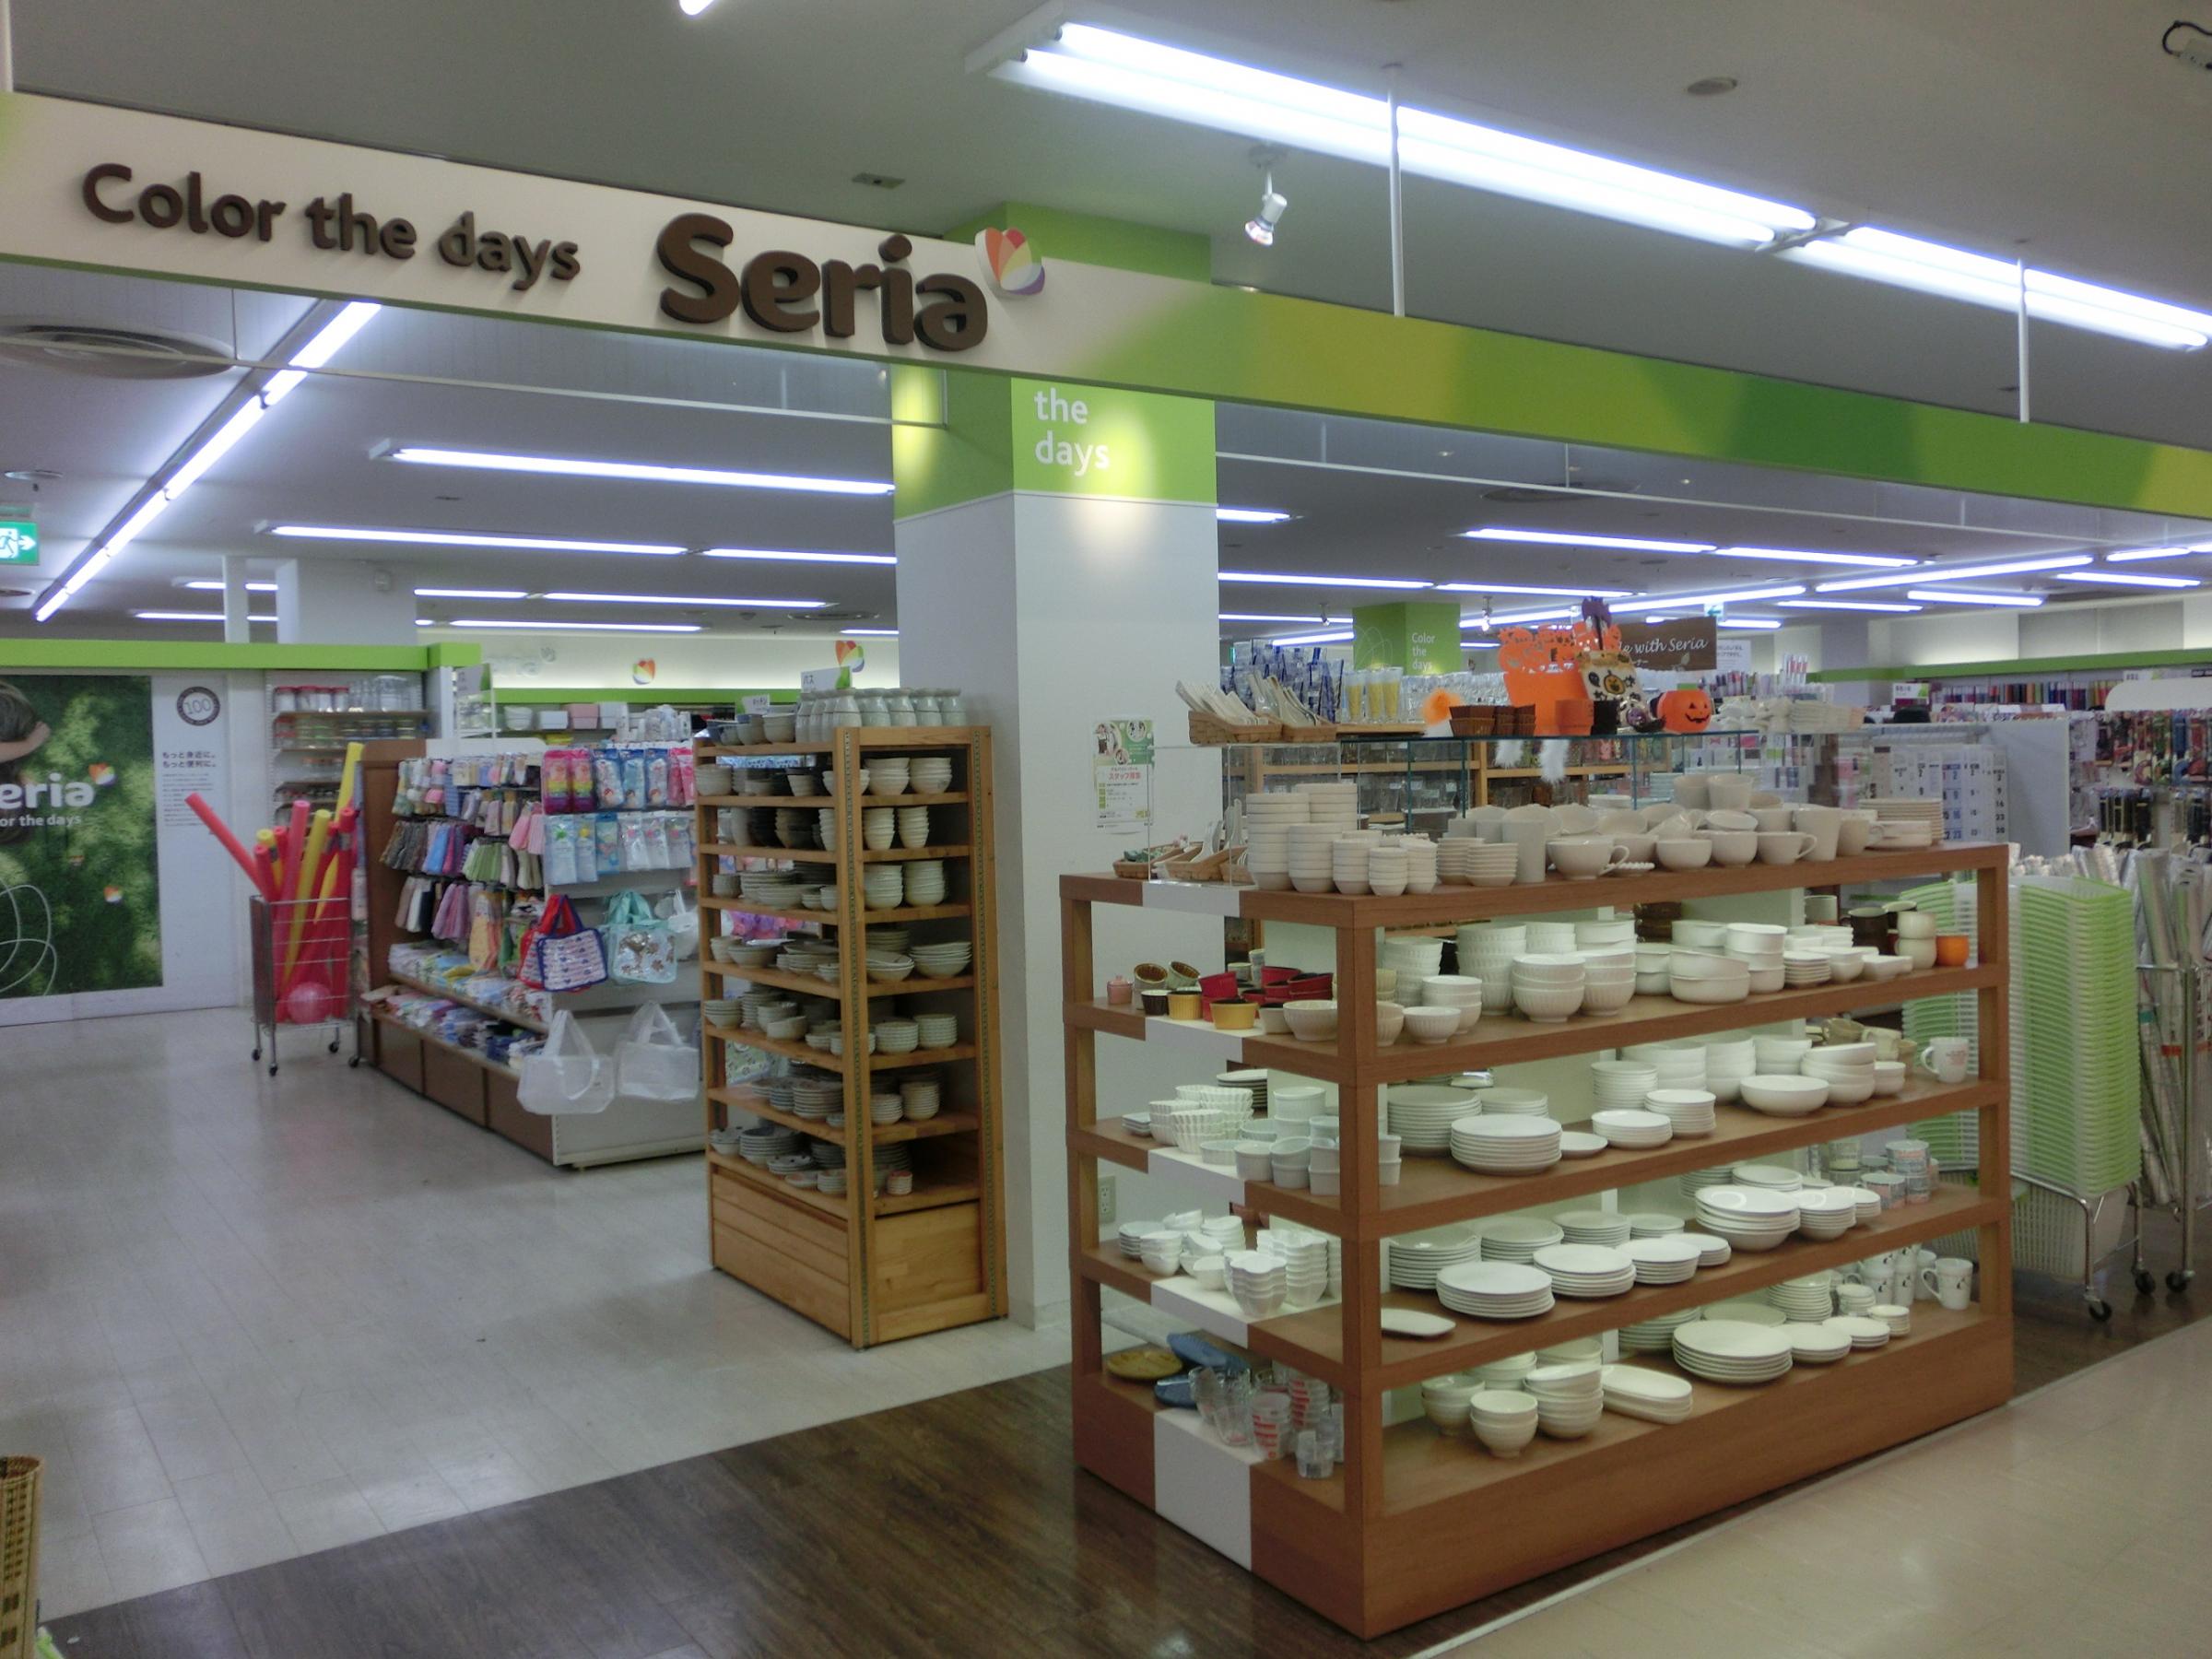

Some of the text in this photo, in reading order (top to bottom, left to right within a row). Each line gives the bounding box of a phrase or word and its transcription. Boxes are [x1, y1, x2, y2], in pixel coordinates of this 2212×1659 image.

[82, 163, 988, 352] Color the days Seria
[1034, 387, 1088, 424] the
[1035, 429, 1111, 477] days
[1412, 630, 1435, 643] Color
[1412, 645, 1427, 656] the
[1635, 638, 1667, 654] with
[1668, 636, 1708, 651] Seria
[1412, 658, 1432, 672] days
[184, 698, 212, 714] 100
[1953, 771, 1959, 780] 2
[0, 772, 95, 808] eria
[19, 815, 44, 827] the
[46, 814, 81, 828] days
